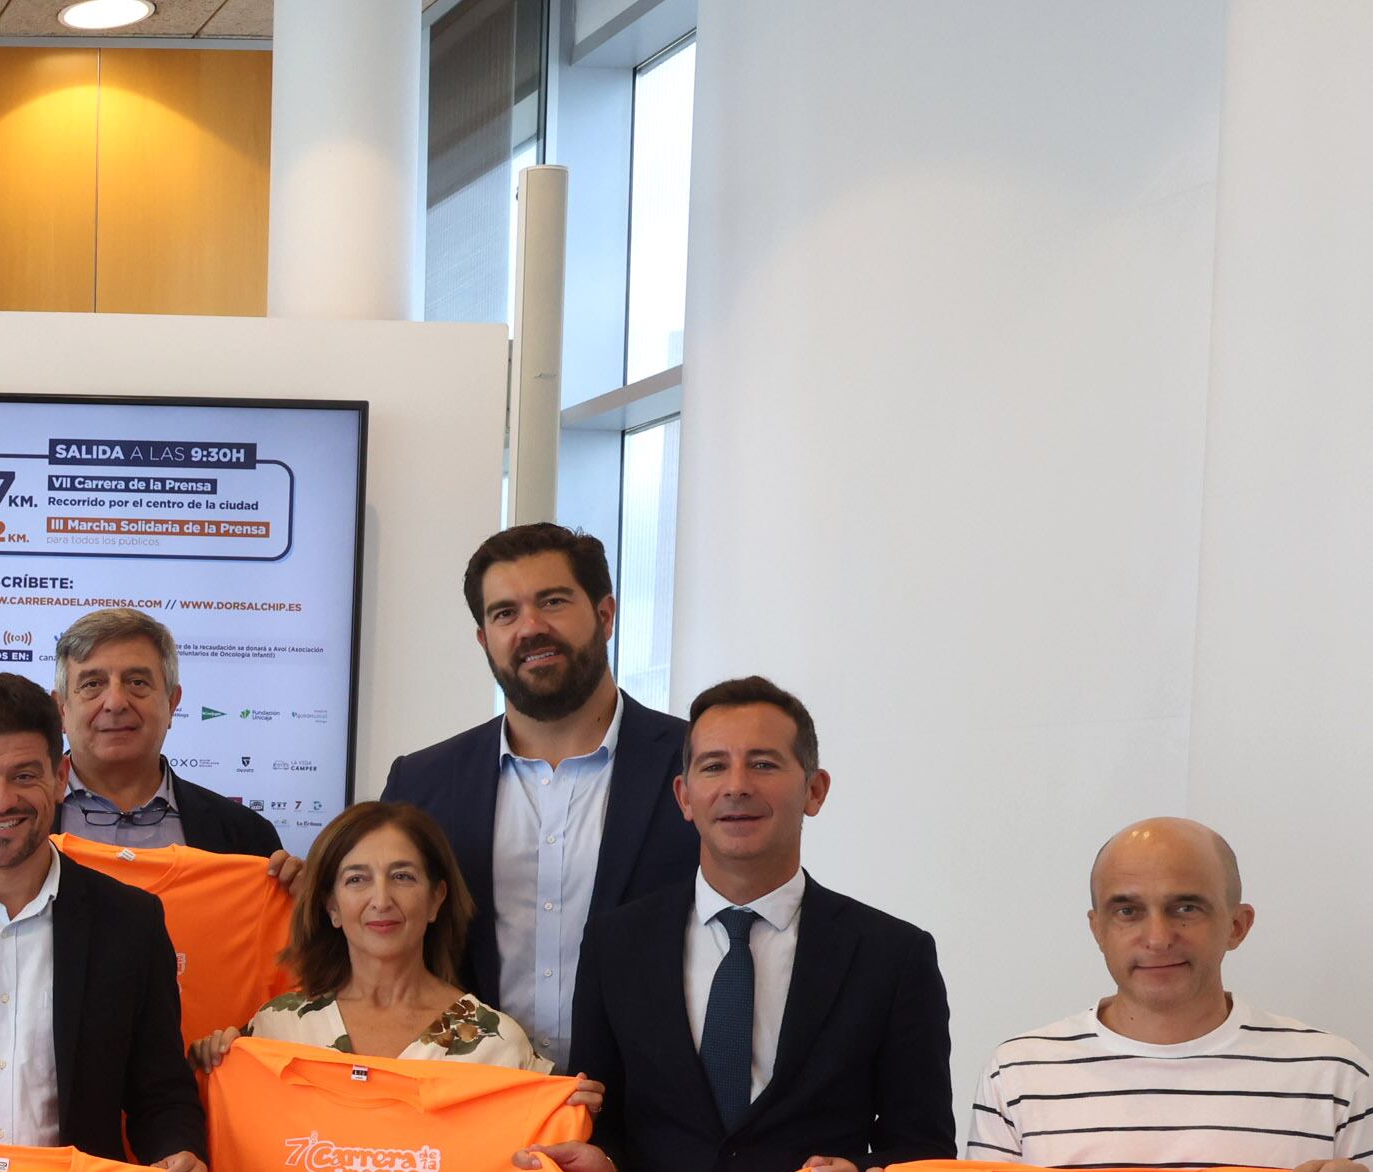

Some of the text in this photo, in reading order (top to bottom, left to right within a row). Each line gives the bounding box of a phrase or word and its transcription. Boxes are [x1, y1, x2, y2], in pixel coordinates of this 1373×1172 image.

[55, 445, 245, 463] SALIDA A LAS 9:30H
[53, 478, 211, 492] VII Carrera de la Prensa
[9, 496, 37, 507] KM.
[48, 497, 259, 511] Recorrido por el centro de la ciudad
[51, 519, 266, 535] III Marcha Solidaria de la Prensa
[8, 534, 29, 543] KM.
[47, 535, 159, 548] para todos los públicos
[180, 600, 302, 612] WWW.DORSALCHIP.ES
[11, 652, 29, 661] EN:
